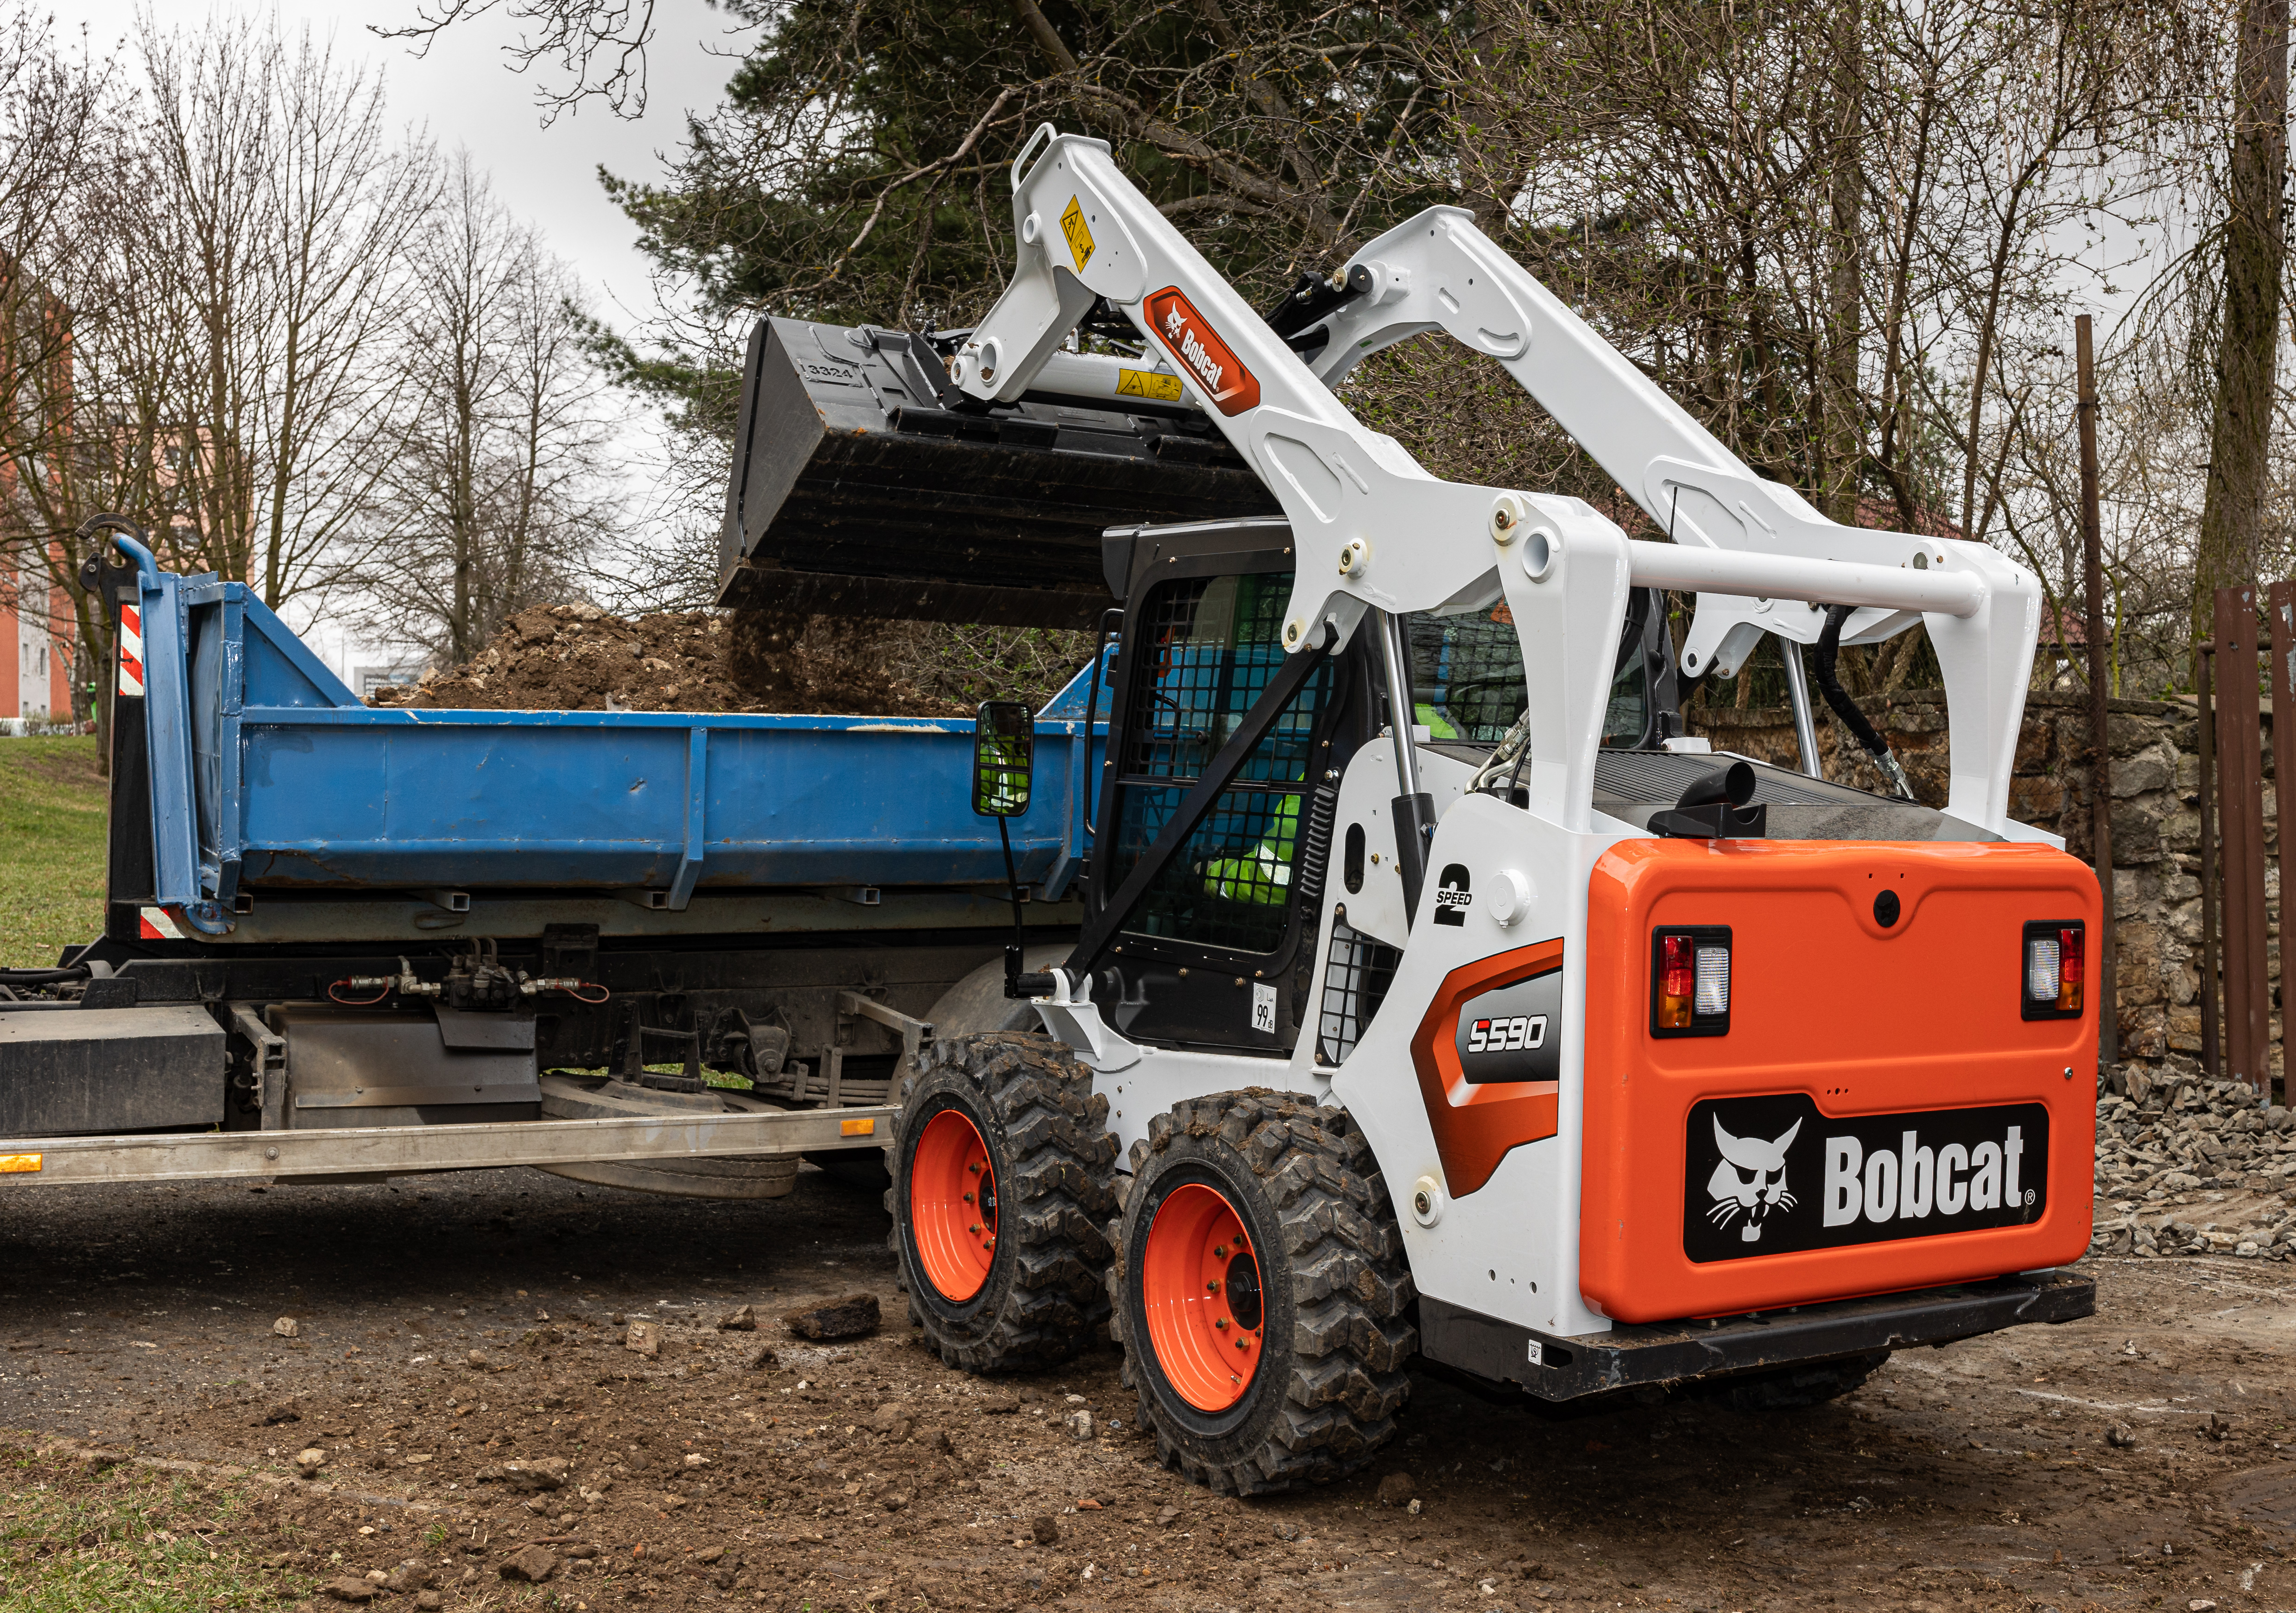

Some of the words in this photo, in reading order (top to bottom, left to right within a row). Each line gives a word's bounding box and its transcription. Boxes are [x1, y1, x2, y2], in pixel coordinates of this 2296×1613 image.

[808, 365, 853, 378] 3324
[1433, 863, 1470, 927] 2
[1436, 890, 1472, 906] SPEED
[1257, 1004, 1268, 1027] 99
[1268, 1020, 1273, 1029] dB
[1467, 1014, 1548, 1053] S590
